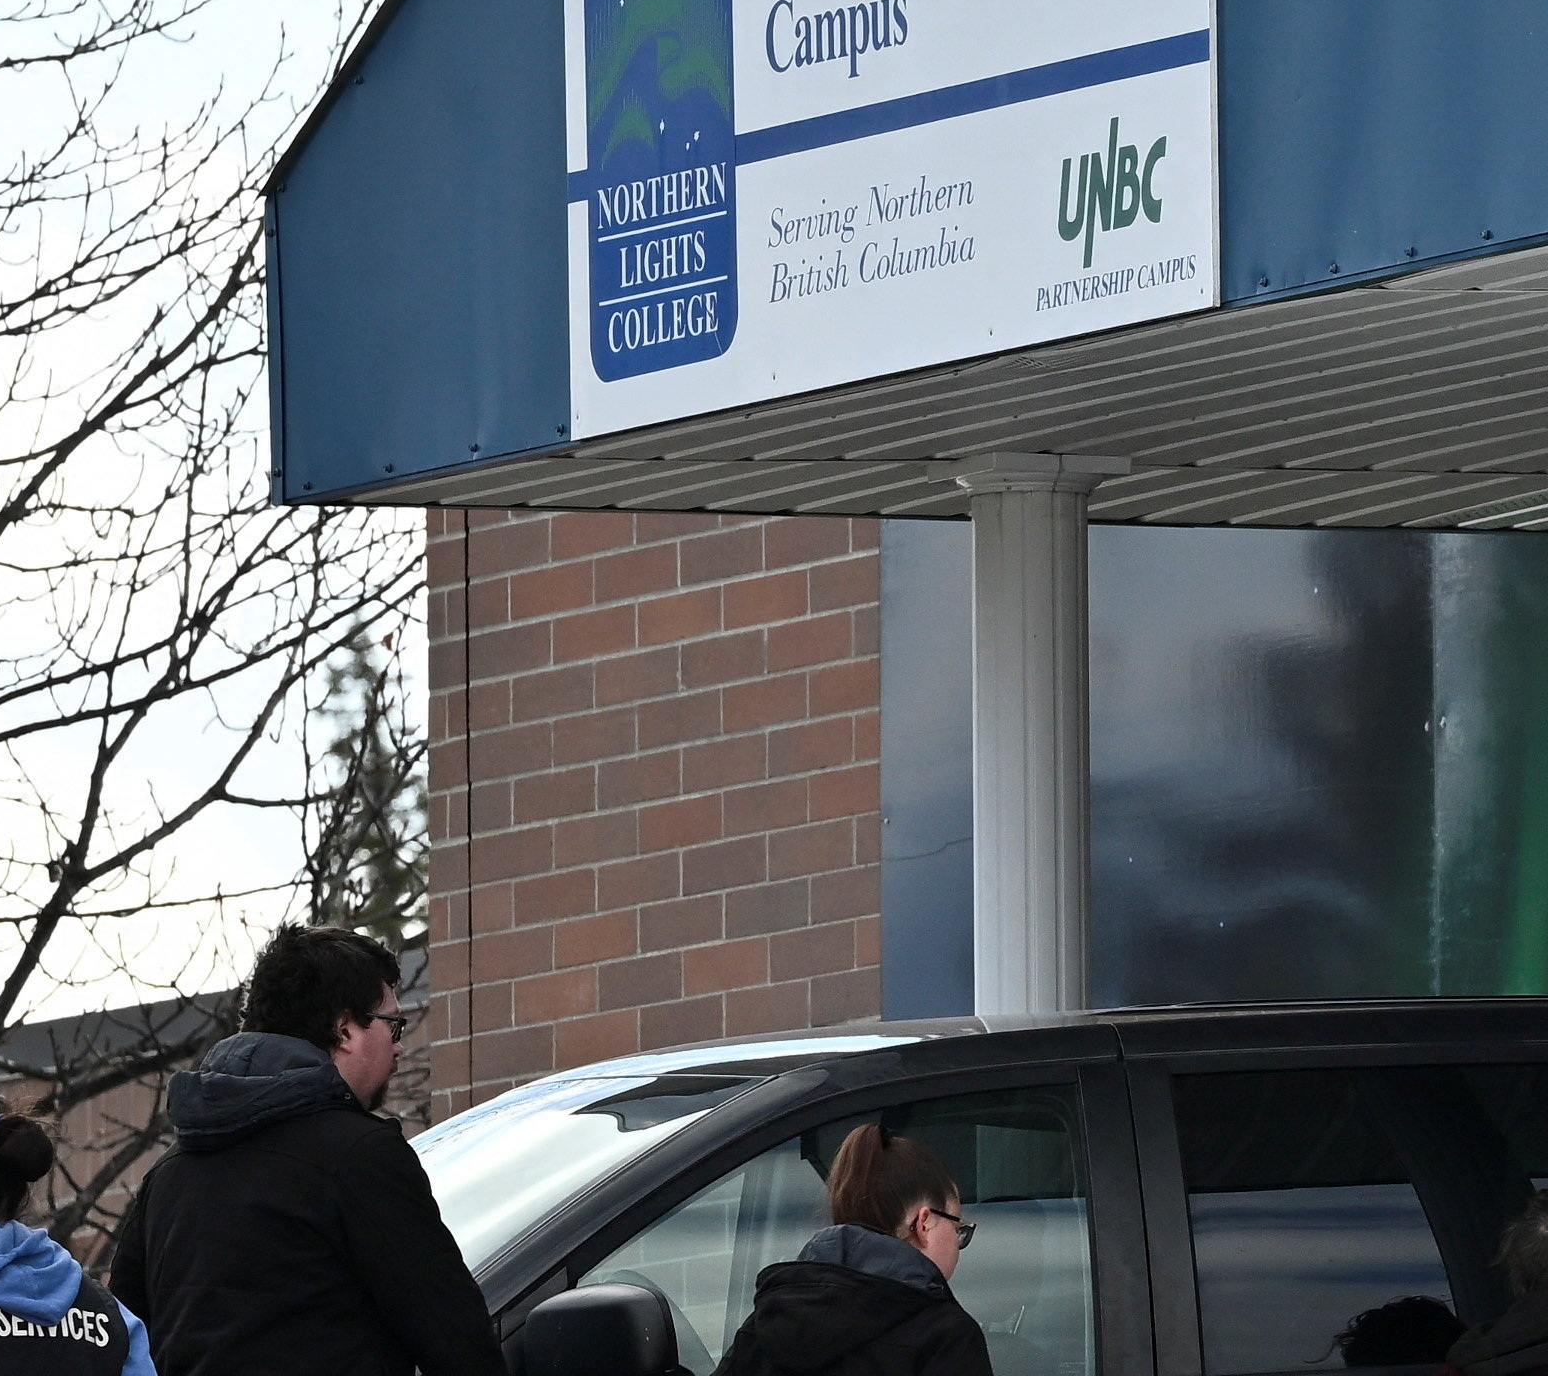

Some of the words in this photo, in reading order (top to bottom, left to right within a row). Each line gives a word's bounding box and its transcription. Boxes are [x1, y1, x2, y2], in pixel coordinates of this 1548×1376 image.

[597, 161, 727, 229] NORTHERN
[767, 197, 859, 249] Serving
[866, 174, 975, 227] Northern
[1058, 116, 1168, 269] UNBC
[620, 230, 707, 289] LIGHTS
[769, 249, 850, 304] British
[859, 224, 976, 284] Columbia
[1035, 267, 1135, 312] PARTNERSHIP
[1137, 254, 1197, 290] CAMPUS
[608, 291, 720, 354] COLLEGE
